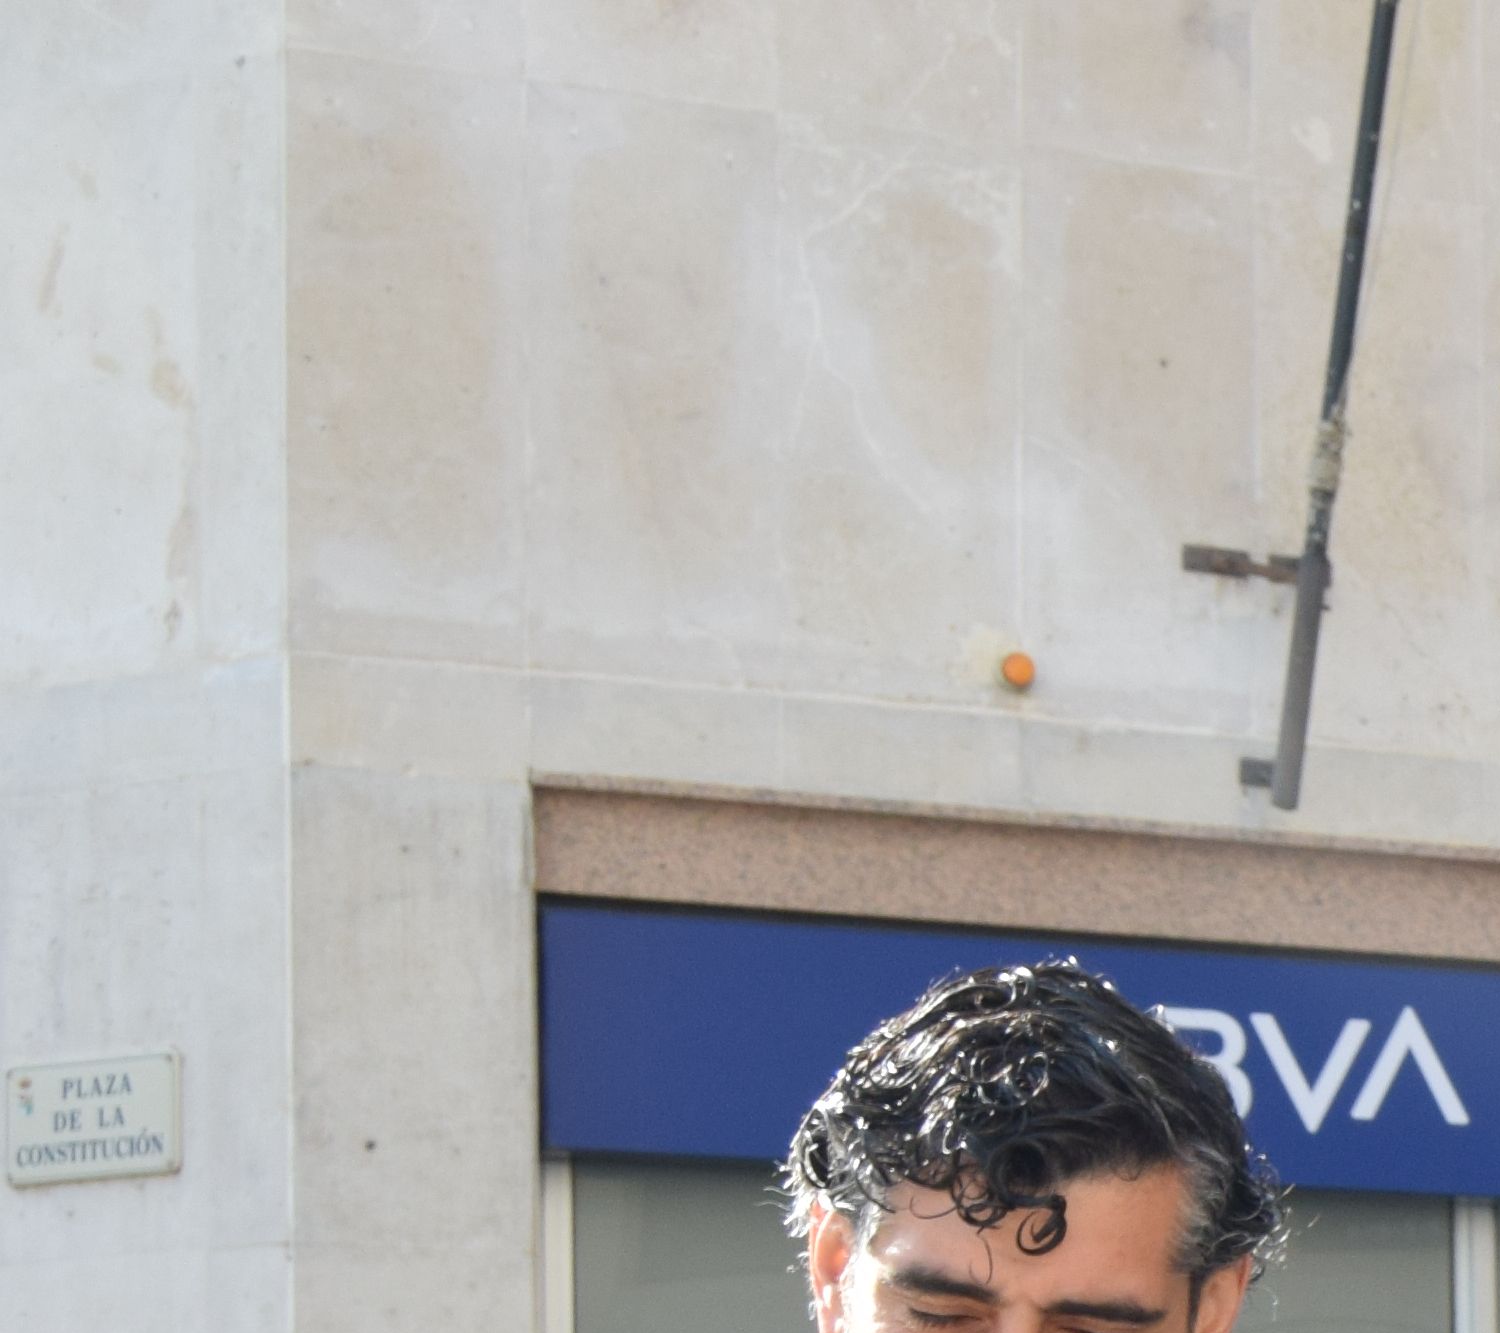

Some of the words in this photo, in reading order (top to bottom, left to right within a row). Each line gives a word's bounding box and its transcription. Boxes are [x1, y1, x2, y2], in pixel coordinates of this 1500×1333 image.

[61, 1072, 132, 1099] PLAZA
[1148, 1004, 1471, 1135] BVA
[53, 1108, 82, 1133] DE
[98, 1106, 125, 1128] LA
[16, 1128, 164, 1168] CONSTITUCIÓN
